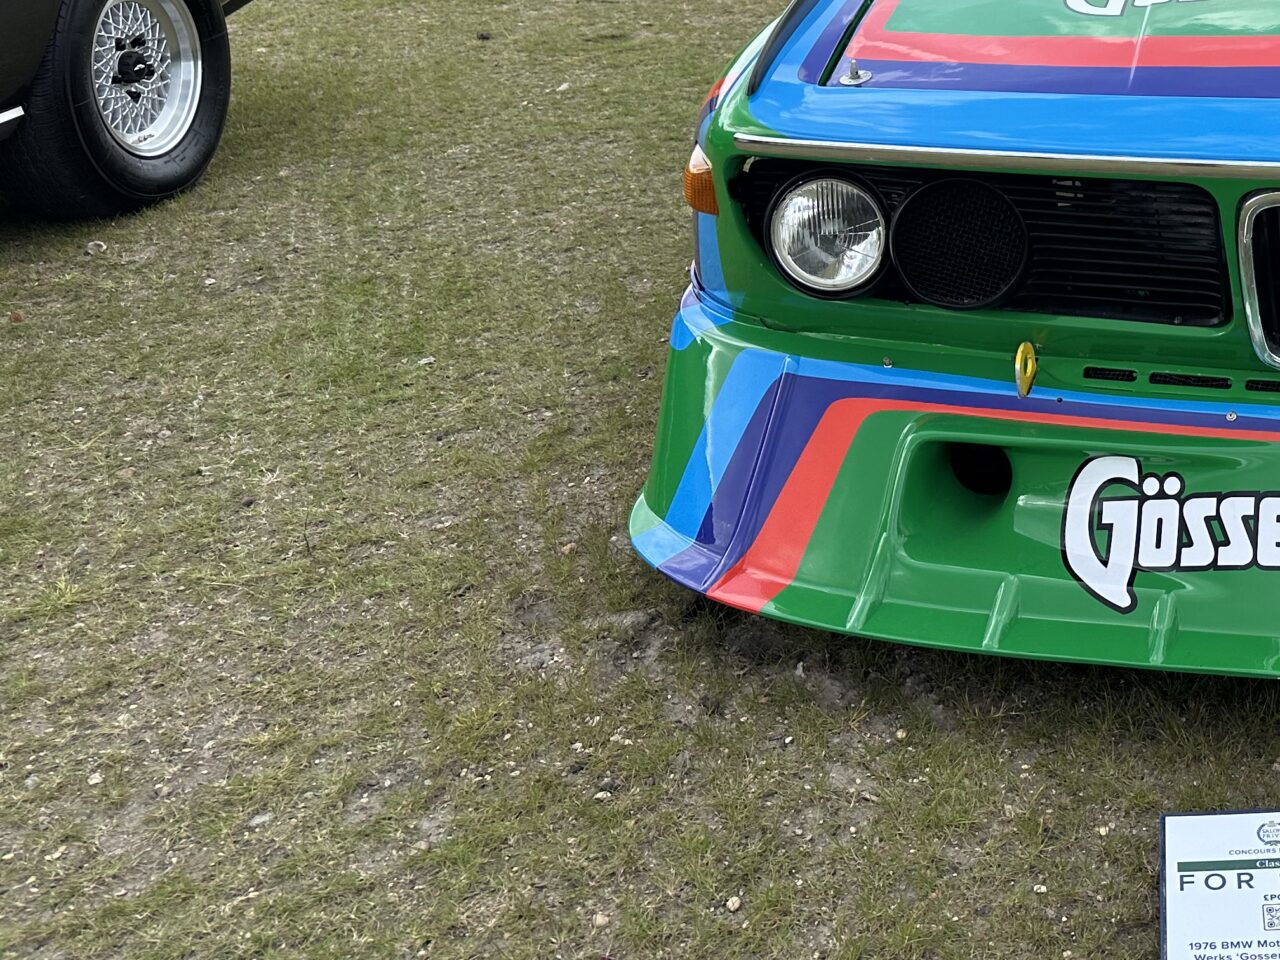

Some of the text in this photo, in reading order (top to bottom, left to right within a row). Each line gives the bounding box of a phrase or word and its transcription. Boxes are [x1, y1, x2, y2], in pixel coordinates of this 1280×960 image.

[1179, 872, 1254, 891] FOR
[1189, 942, 1217, 950] 1976
[1221, 941, 1253, 949] BMW
